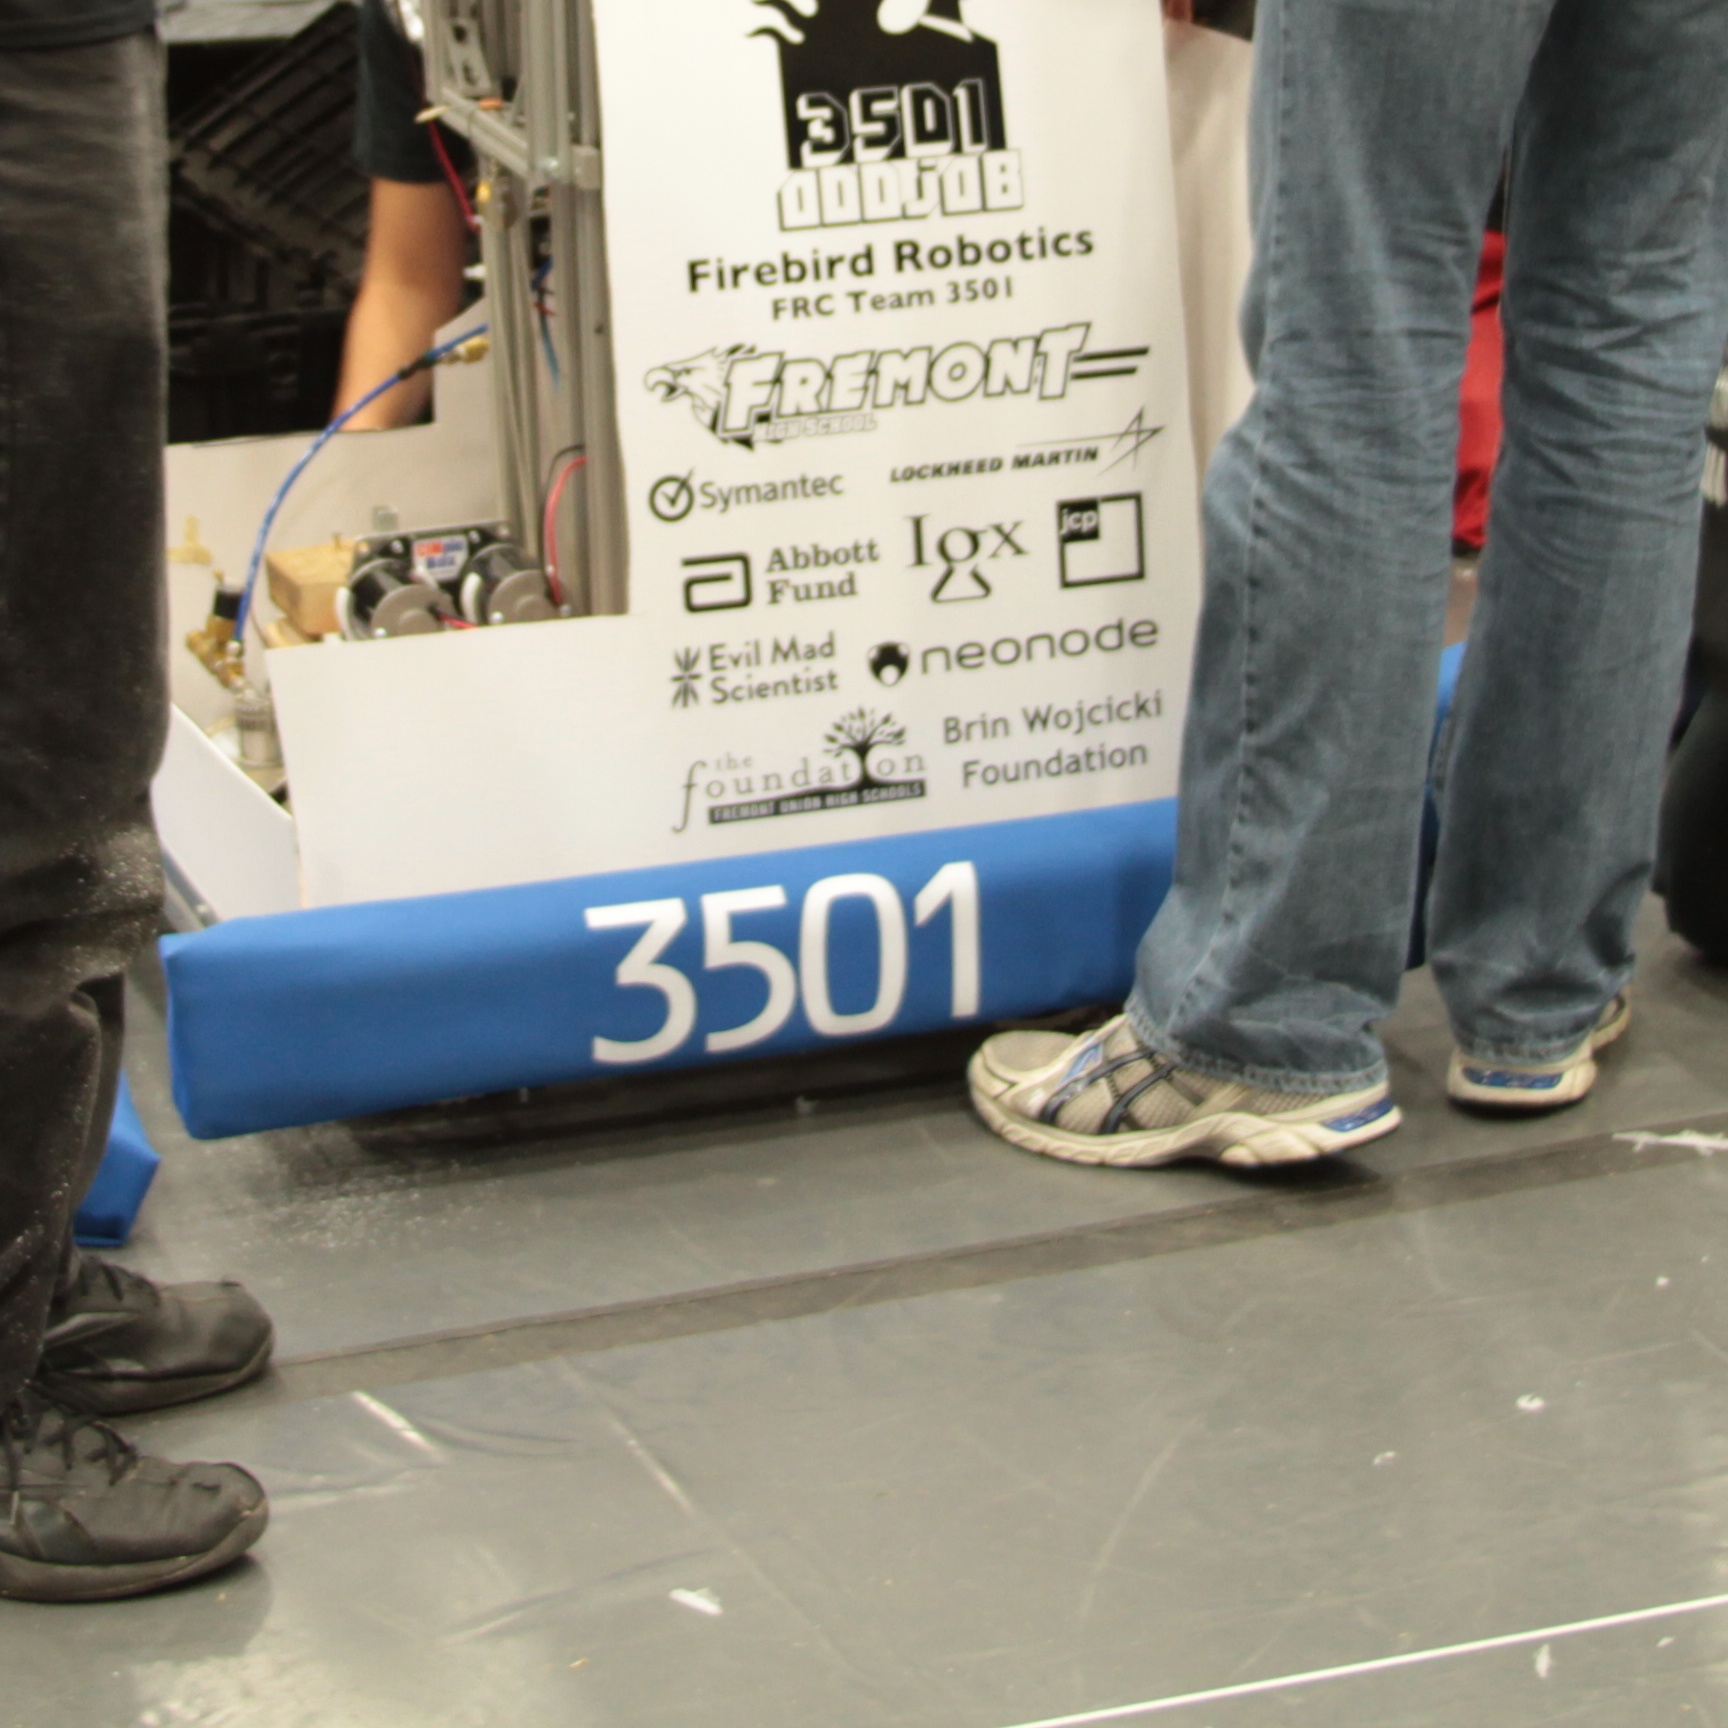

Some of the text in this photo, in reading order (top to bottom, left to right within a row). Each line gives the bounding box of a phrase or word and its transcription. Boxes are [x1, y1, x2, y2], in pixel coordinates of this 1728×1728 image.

[796, 77, 990, 168] 3501
[688, 227, 1094, 293] Firebird Robotics
[771, 276, 1014, 321] FRC Team 3501
[719, 322, 1092, 438] FREMONT
[752, 411, 877, 442] HIGH SCHOOL
[889, 446, 1099, 483] LOCKHEED MARTIN
[699, 474, 844, 512] Symantec
[1059, 507, 1099, 536] jcp
[765, 537, 880, 572] Abbott
[766, 573, 859, 605] Fund
[708, 631, 837, 672] Evil Mad
[921, 618, 1159, 674] neonode
[710, 670, 840, 705] Scientist
[943, 690, 1164, 745] Brin Wojcicki
[715, 753, 754, 770] the
[962, 743, 1148, 788] Foundation
[714, 781, 922, 822] FREMONT UNION HIGH SCHOOLS
[583, 860, 982, 1067] 3501
